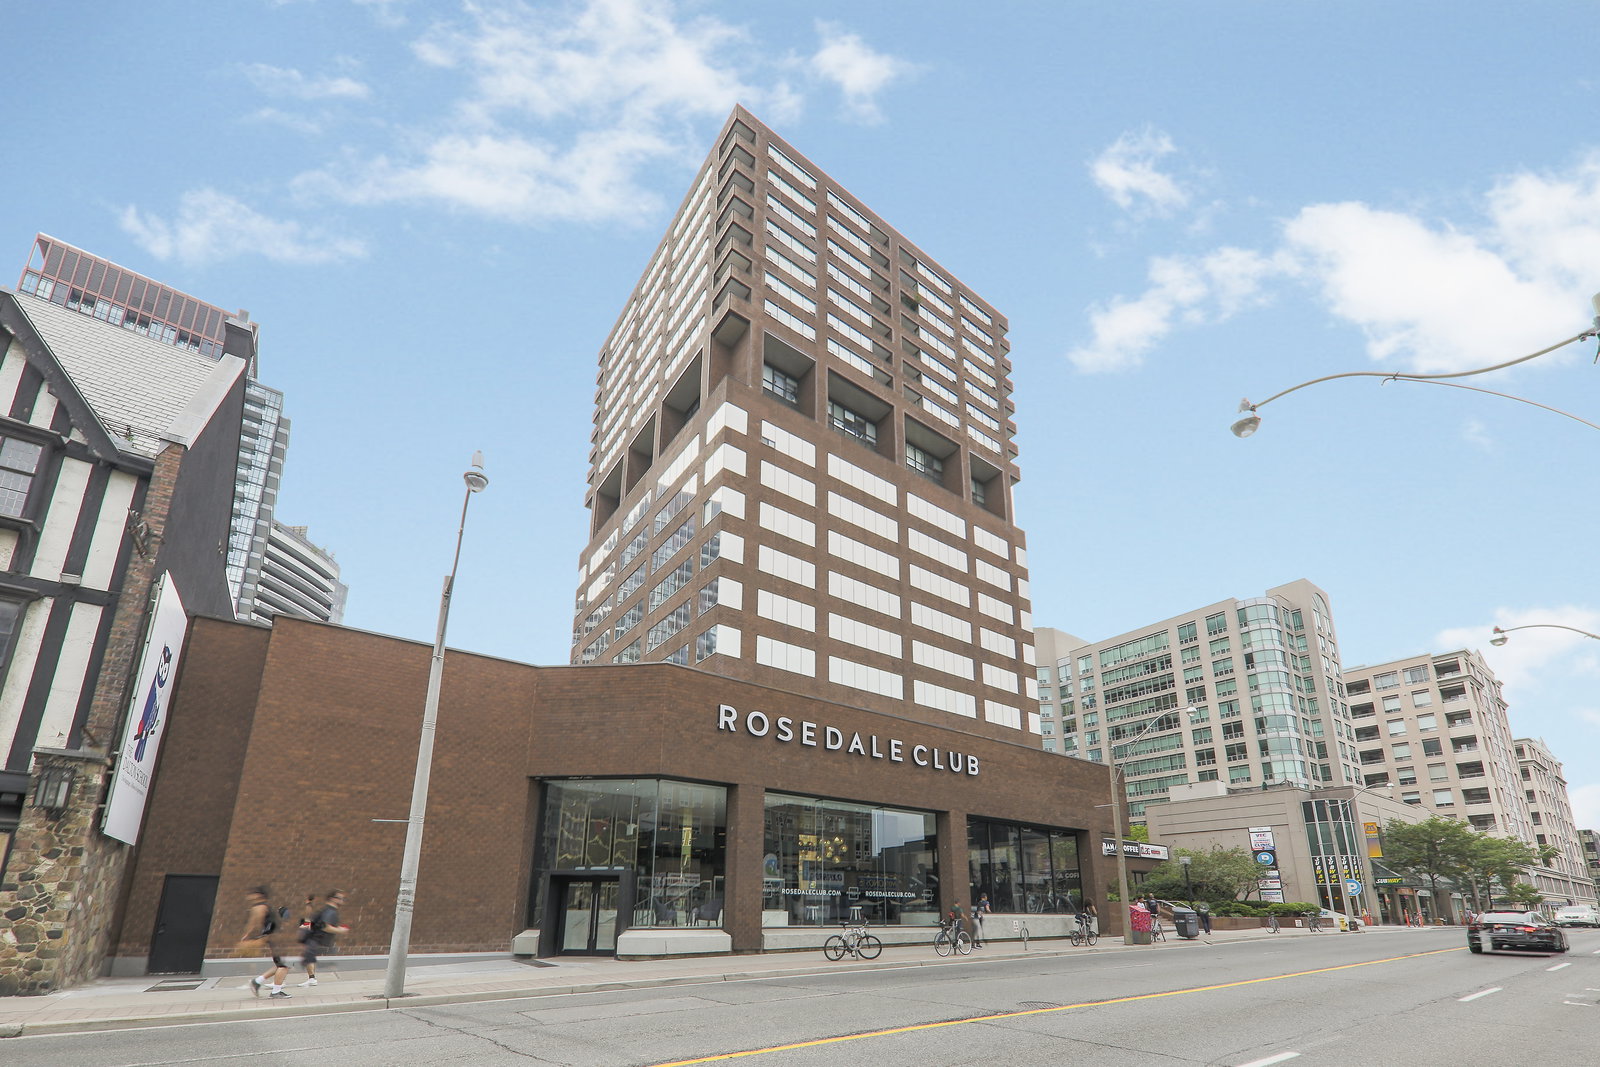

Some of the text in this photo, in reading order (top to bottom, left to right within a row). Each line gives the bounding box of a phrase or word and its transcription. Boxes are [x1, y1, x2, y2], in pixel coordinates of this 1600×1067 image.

[718, 703, 980, 776] ROSEDALE CLUB
[1315, 856, 1324, 884] SUBWAY
[1328, 856, 1338, 884] SUBWAY
[1341, 856, 1350, 879] SUBWA
[781, 888, 842, 896] ROSEDALECLUB.COM
[865, 890, 916, 898] ROSEDALECLUB.COM
